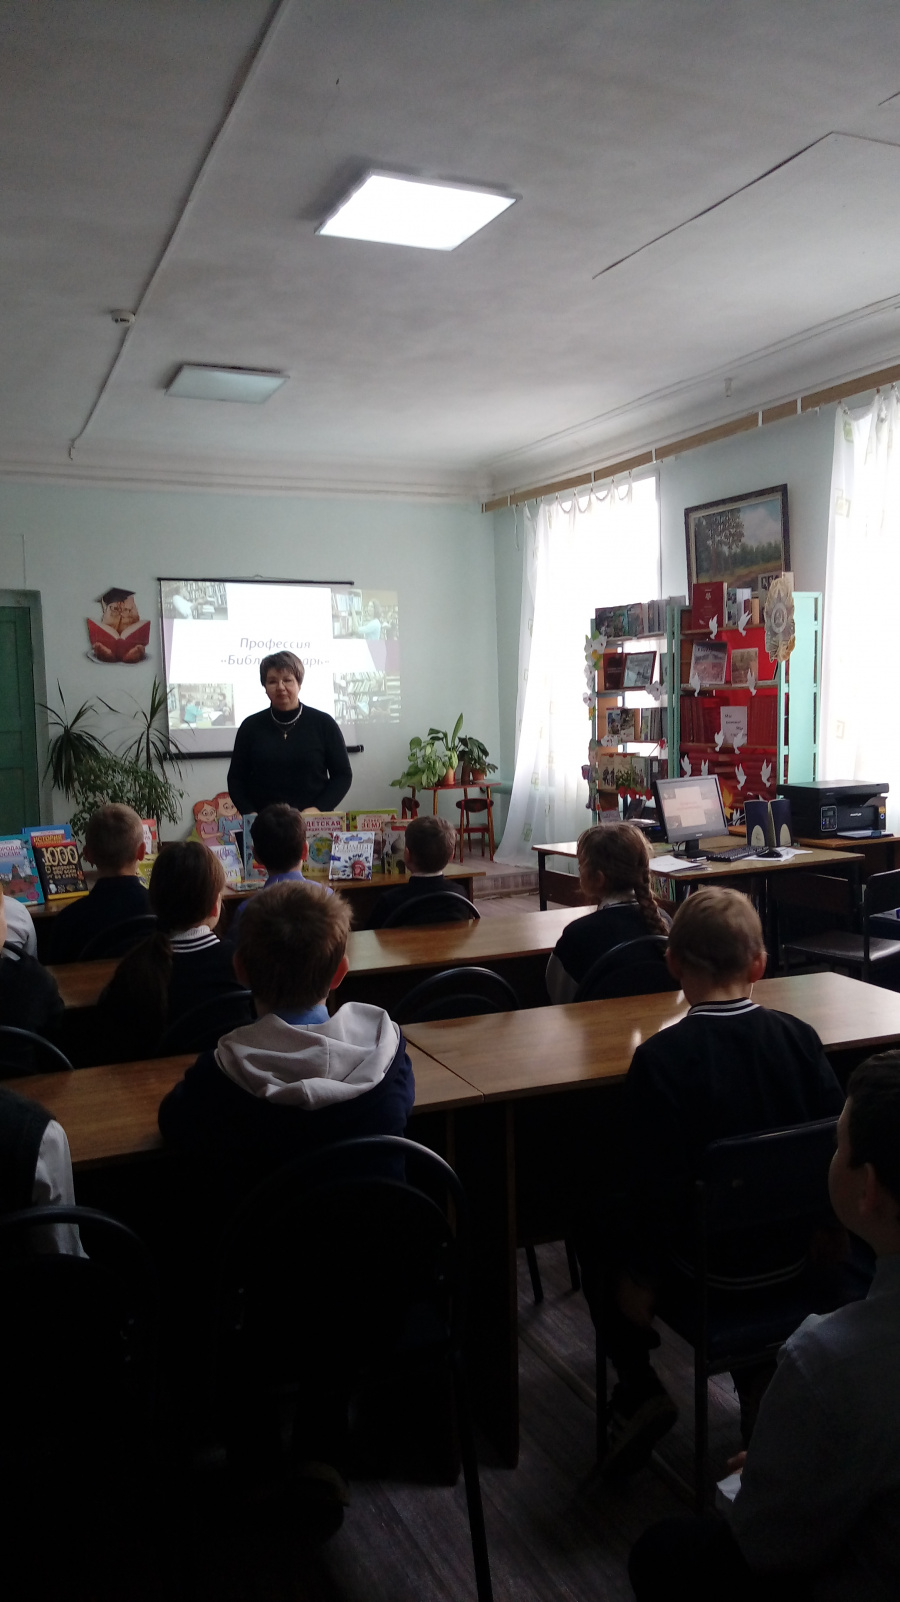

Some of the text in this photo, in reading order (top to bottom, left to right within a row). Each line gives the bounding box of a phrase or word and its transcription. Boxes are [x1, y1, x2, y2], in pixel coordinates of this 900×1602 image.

[240, 638, 311, 650] Профессия
[220, 655, 330, 667] «Библарь»
[41, 845, 78, 866] 1000
